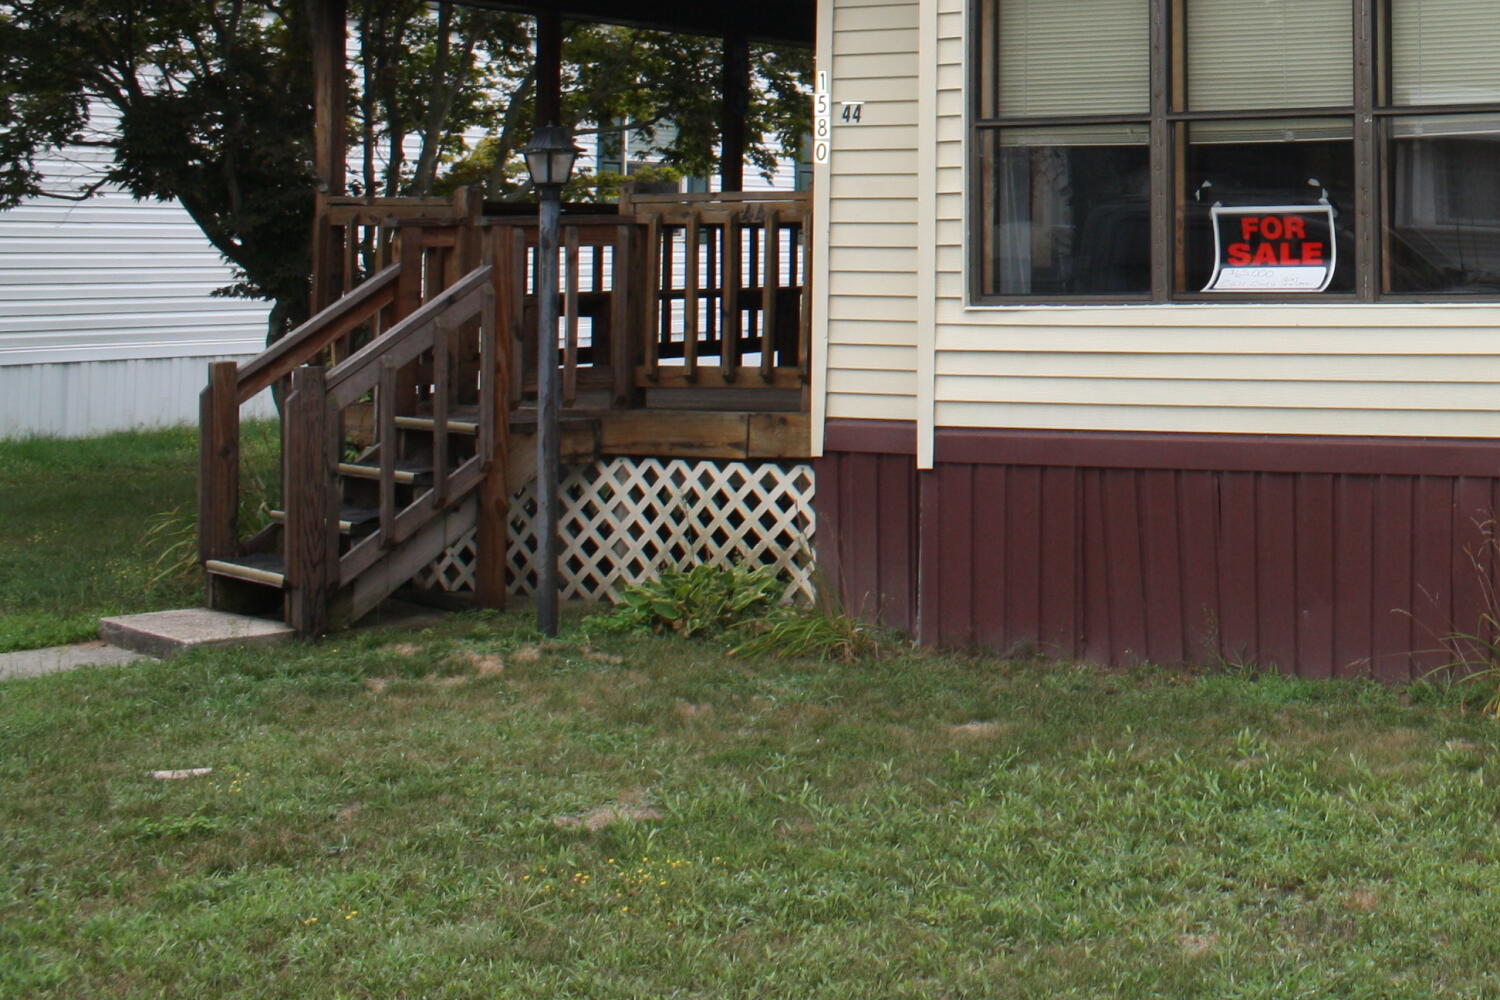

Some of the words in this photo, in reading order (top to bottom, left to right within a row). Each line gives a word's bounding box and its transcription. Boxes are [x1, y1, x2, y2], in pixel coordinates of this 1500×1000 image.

[815, 72, 828, 161] 1580
[842, 104, 861, 123] 44
[1240, 216, 1306, 240] FOR
[1227, 242, 1324, 266] SALE
